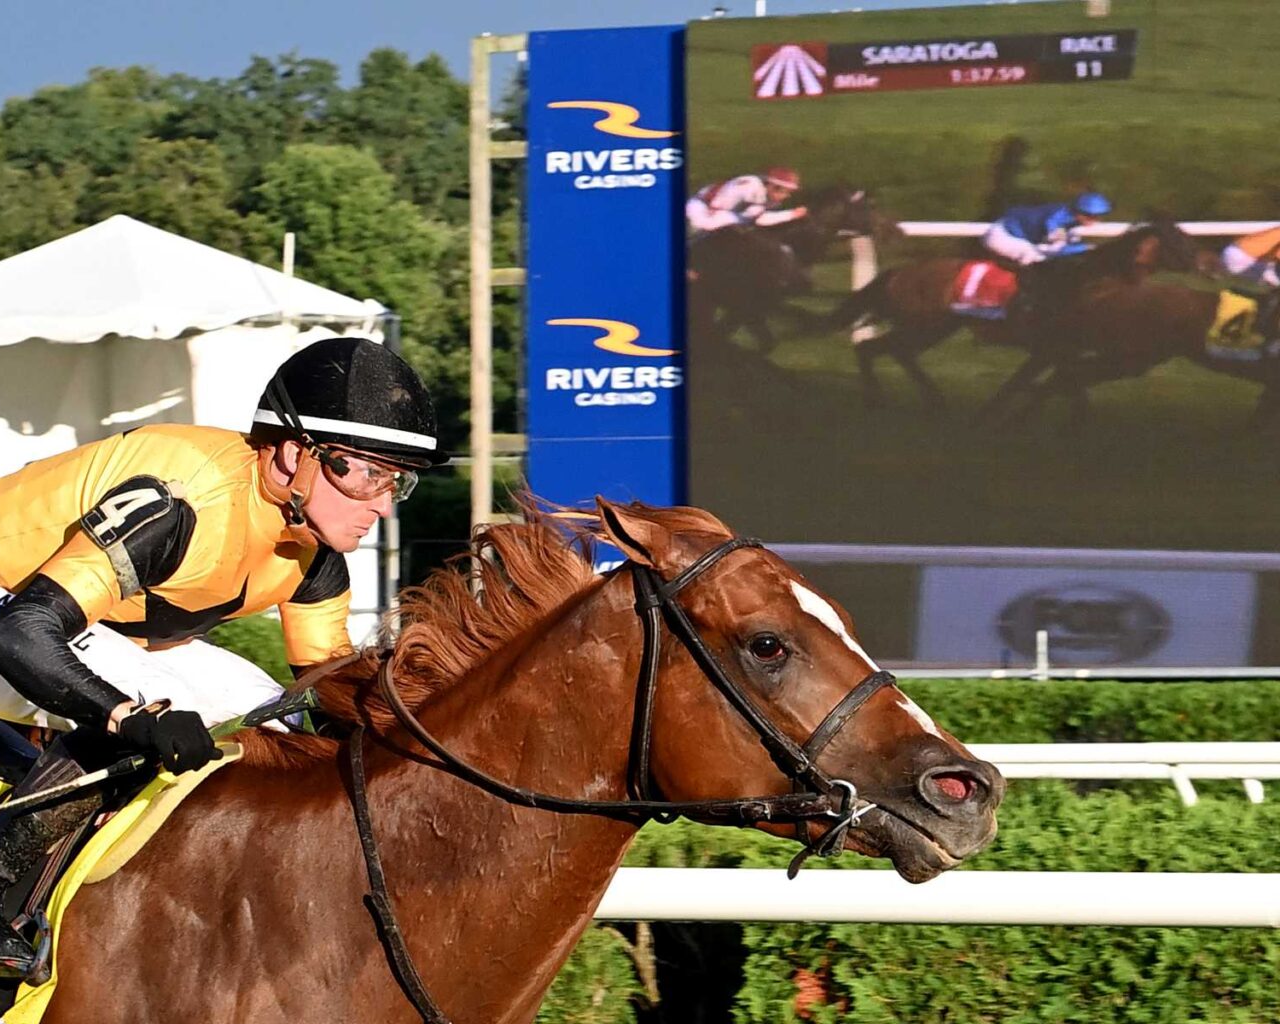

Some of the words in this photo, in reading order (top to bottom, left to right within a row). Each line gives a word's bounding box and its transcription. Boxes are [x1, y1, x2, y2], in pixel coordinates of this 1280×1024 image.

[862, 41, 999, 65] SARATOGA
[1060, 34, 1117, 54] RACE
[546, 148, 684, 174] RIVERS
[574, 173, 656, 189] CASINO
[546, 366, 684, 390] RIVERS
[574, 391, 657, 406] CASINO
[92, 487, 163, 537] 4
